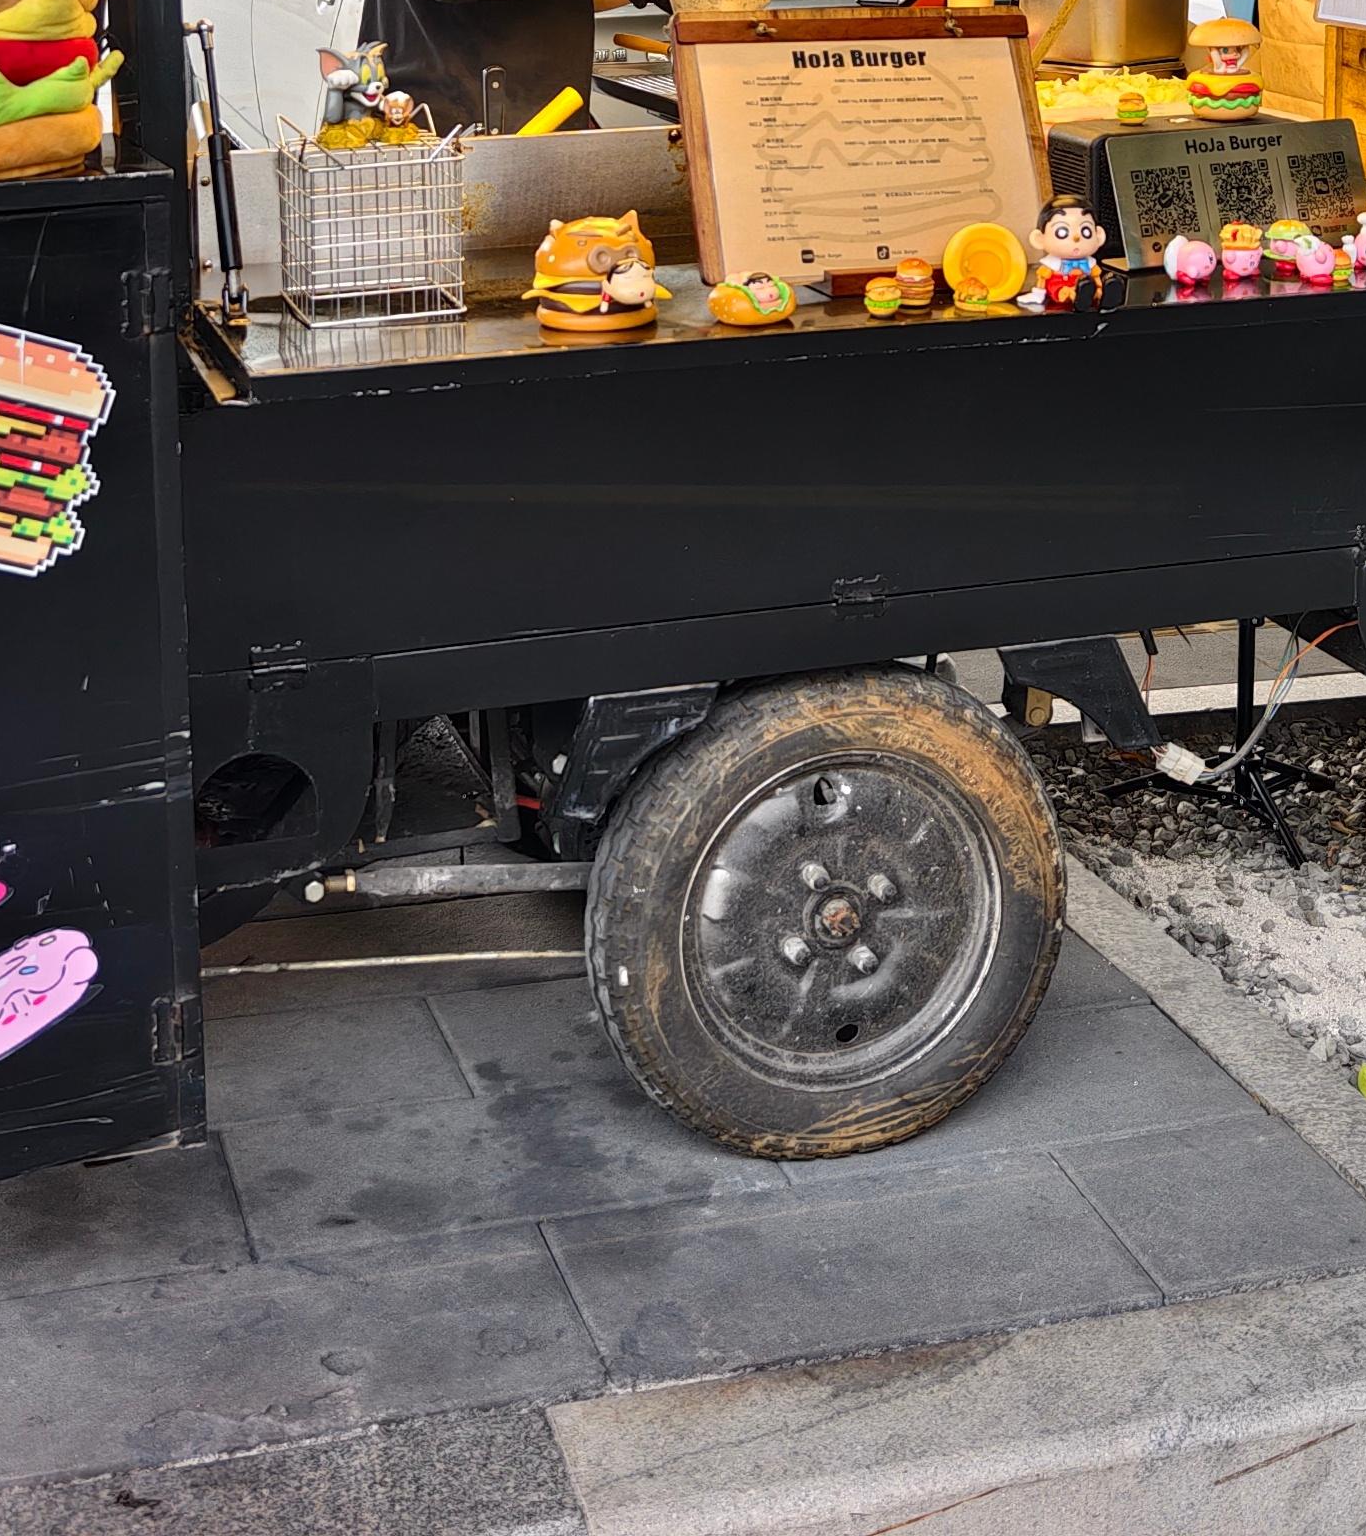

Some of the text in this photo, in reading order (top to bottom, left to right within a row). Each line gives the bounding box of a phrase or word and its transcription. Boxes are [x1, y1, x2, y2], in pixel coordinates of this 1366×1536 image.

[791, 49, 927, 69] HoJa Burger
[1184, 135, 1283, 155] HoJa Burger
